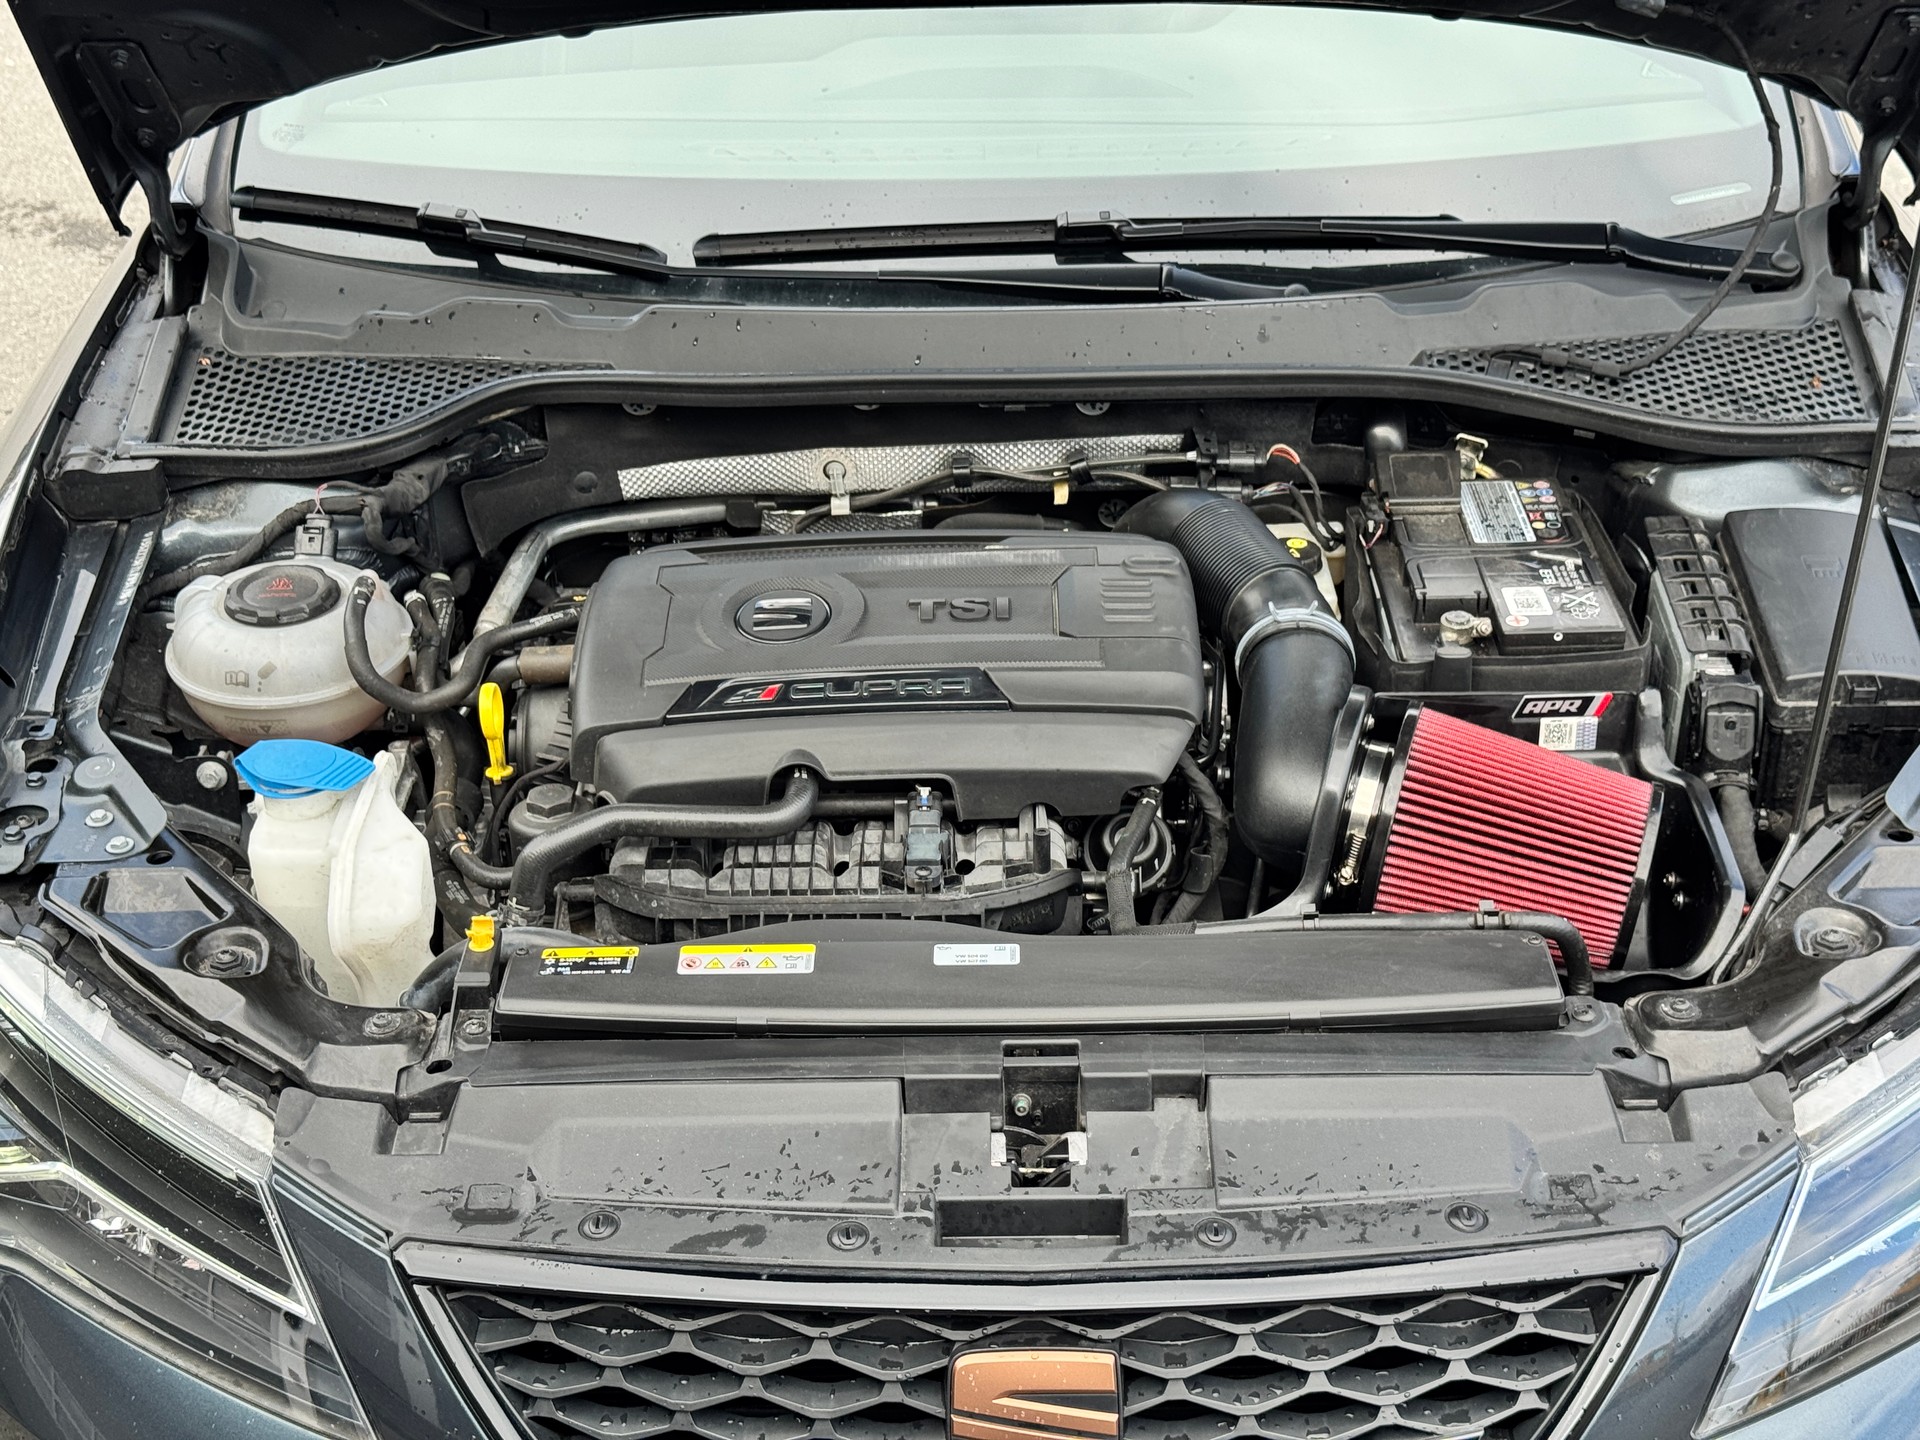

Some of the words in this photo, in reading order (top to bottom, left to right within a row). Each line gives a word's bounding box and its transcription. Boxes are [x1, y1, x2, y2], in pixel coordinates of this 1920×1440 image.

[907, 598, 1012, 622] TSI
[789, 677, 972, 700] CUPRA
[1522, 699, 1583, 714] APR
